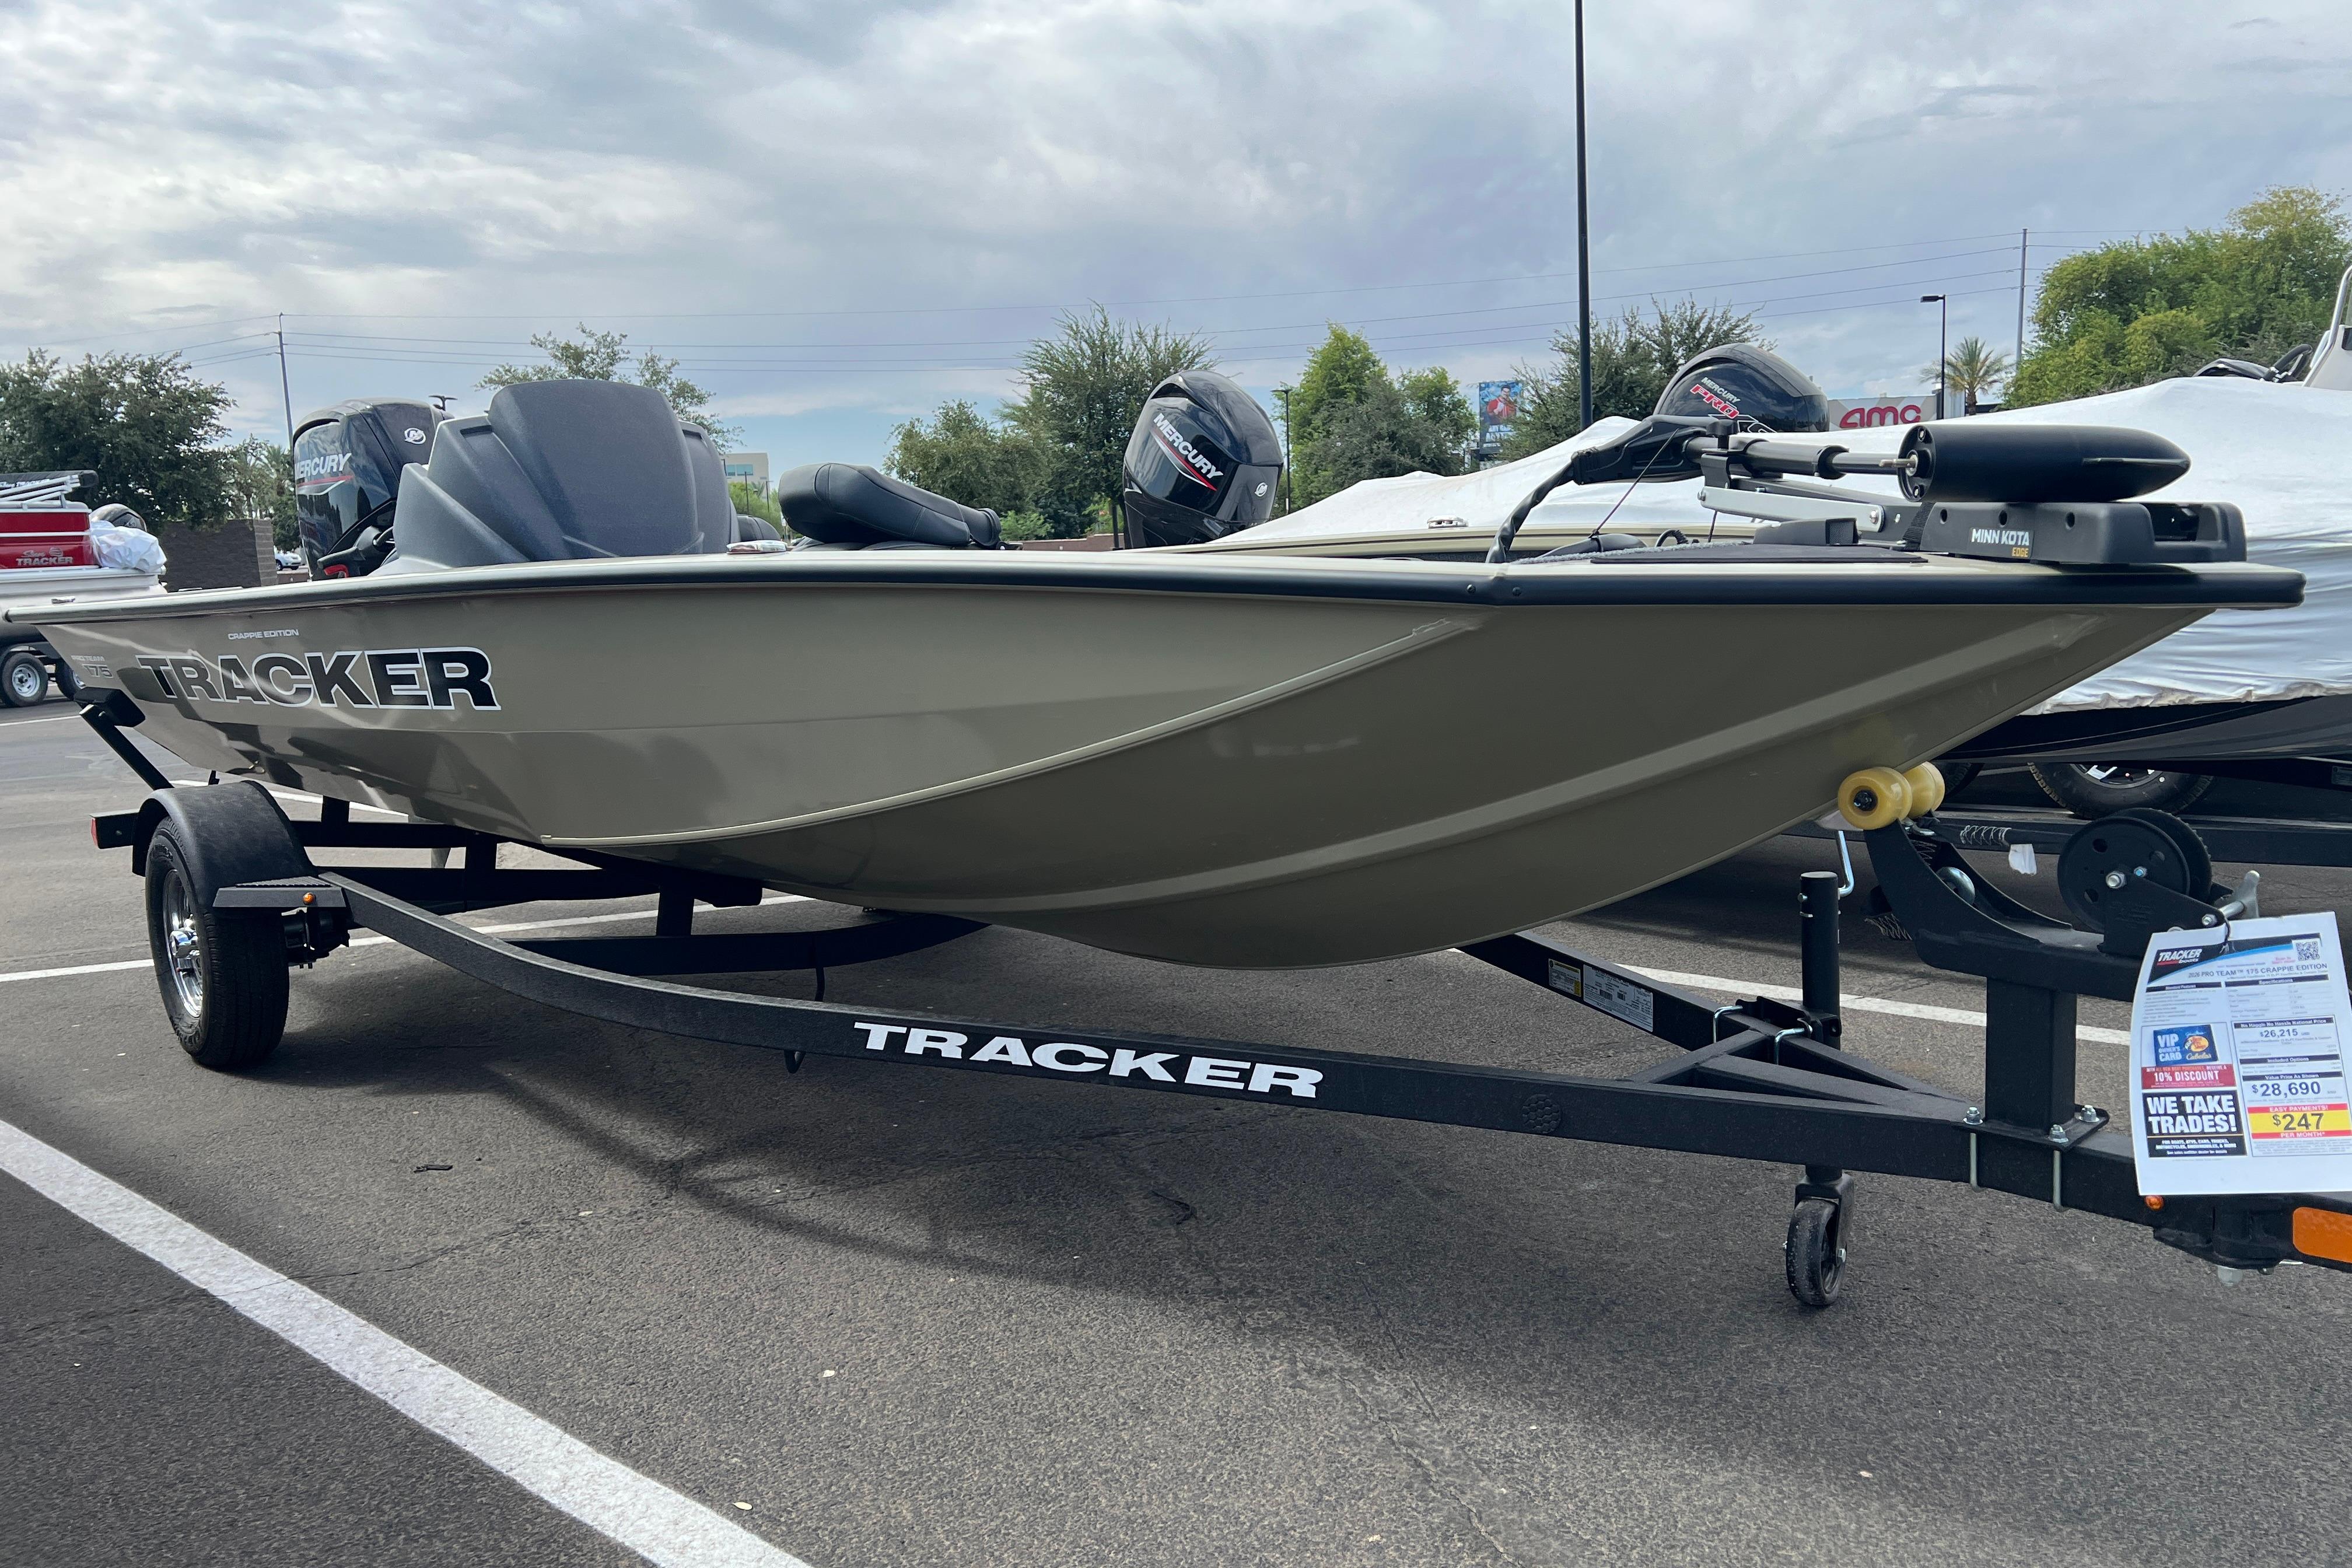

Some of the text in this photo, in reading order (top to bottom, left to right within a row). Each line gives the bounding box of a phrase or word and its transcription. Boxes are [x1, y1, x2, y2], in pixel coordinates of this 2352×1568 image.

[1702, 377, 1741, 402] MERCURY
[1690, 384, 1740, 419] PRO
[1153, 413, 1223, 478] MERCURY
[1972, 528, 2029, 546] MINN KOTA
[2011, 547, 2029, 557] EDGE
[16, 556, 73, 566] TRACKER
[228, 629, 299, 640] CRAPPIE EDITION
[82, 663, 113, 678] 175
[135, 646, 502, 710] TRACKER
[2158, 949, 2203, 962] TRACKER
[2296, 963, 2328, 971] EDITION
[2157, 1034, 2179, 1048] VIP
[2260, 1028, 2298, 1038] $26,215
[853, 1021, 1323, 1098] TRACKER
[2160, 1052, 2182, 1062] CARD
[2154, 1070, 2219, 1082] 10% DISCOUNT
[2252, 1081, 2321, 1098] $28,690
[2147, 1097, 2179, 1114] WE
[2182, 1095, 2236, 1113] TAKE
[2148, 1115, 2238, 1134] TRADES!
[2272, 1113, 2324, 1131] $247
